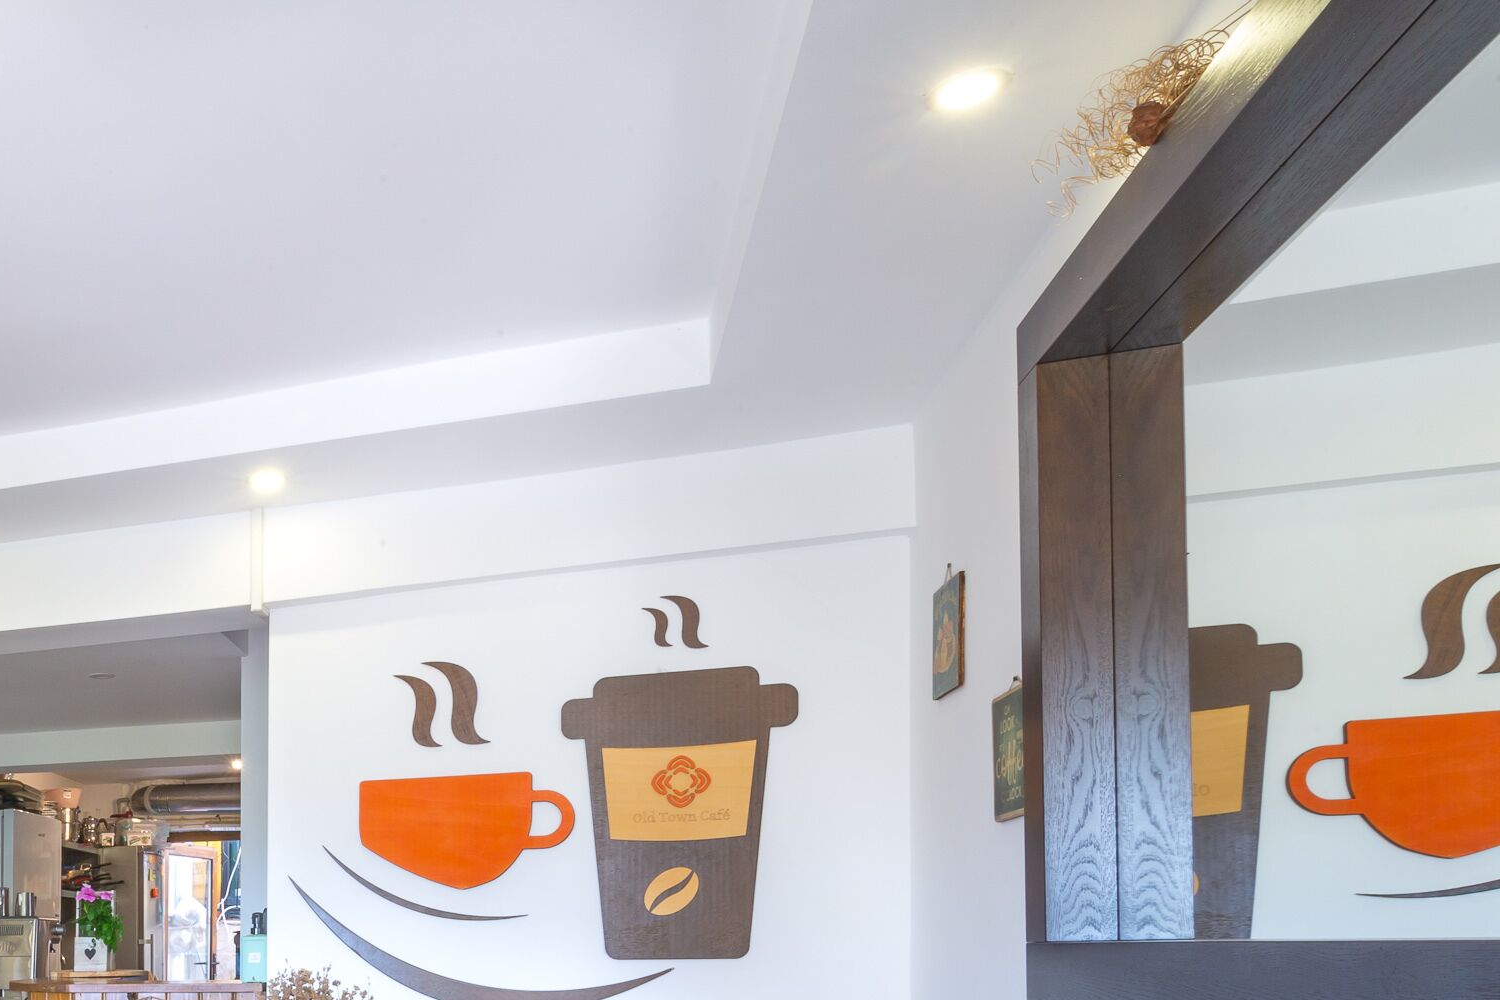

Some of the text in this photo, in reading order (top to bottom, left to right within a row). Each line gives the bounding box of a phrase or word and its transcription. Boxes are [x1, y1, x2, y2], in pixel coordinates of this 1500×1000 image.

[632, 808, 731, 824] Old Town Café
